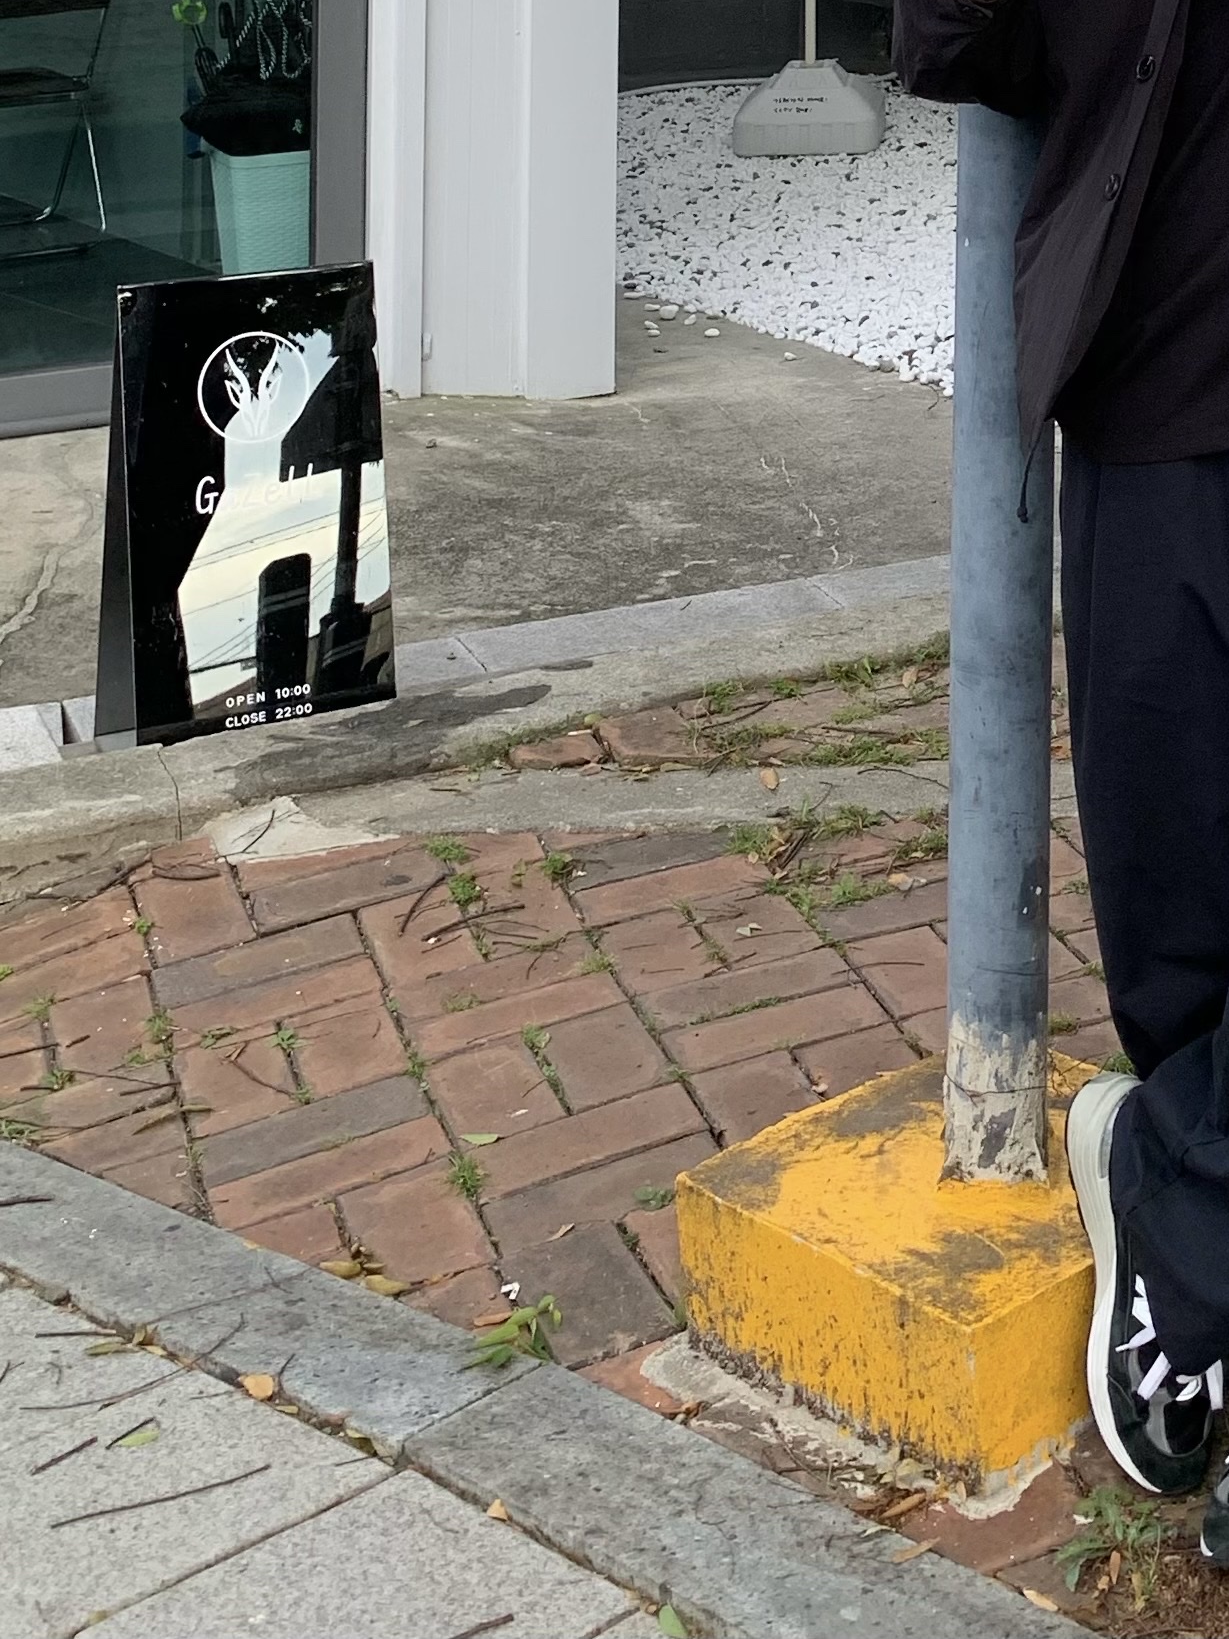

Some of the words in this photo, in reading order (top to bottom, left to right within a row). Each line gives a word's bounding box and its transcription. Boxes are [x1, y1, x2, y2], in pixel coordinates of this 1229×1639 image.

[225, 691, 266, 708] OPEN
[275, 683, 311, 699] 10:00
[225, 711, 267, 728] CLOSE
[275, 703, 313, 719] 22:00
